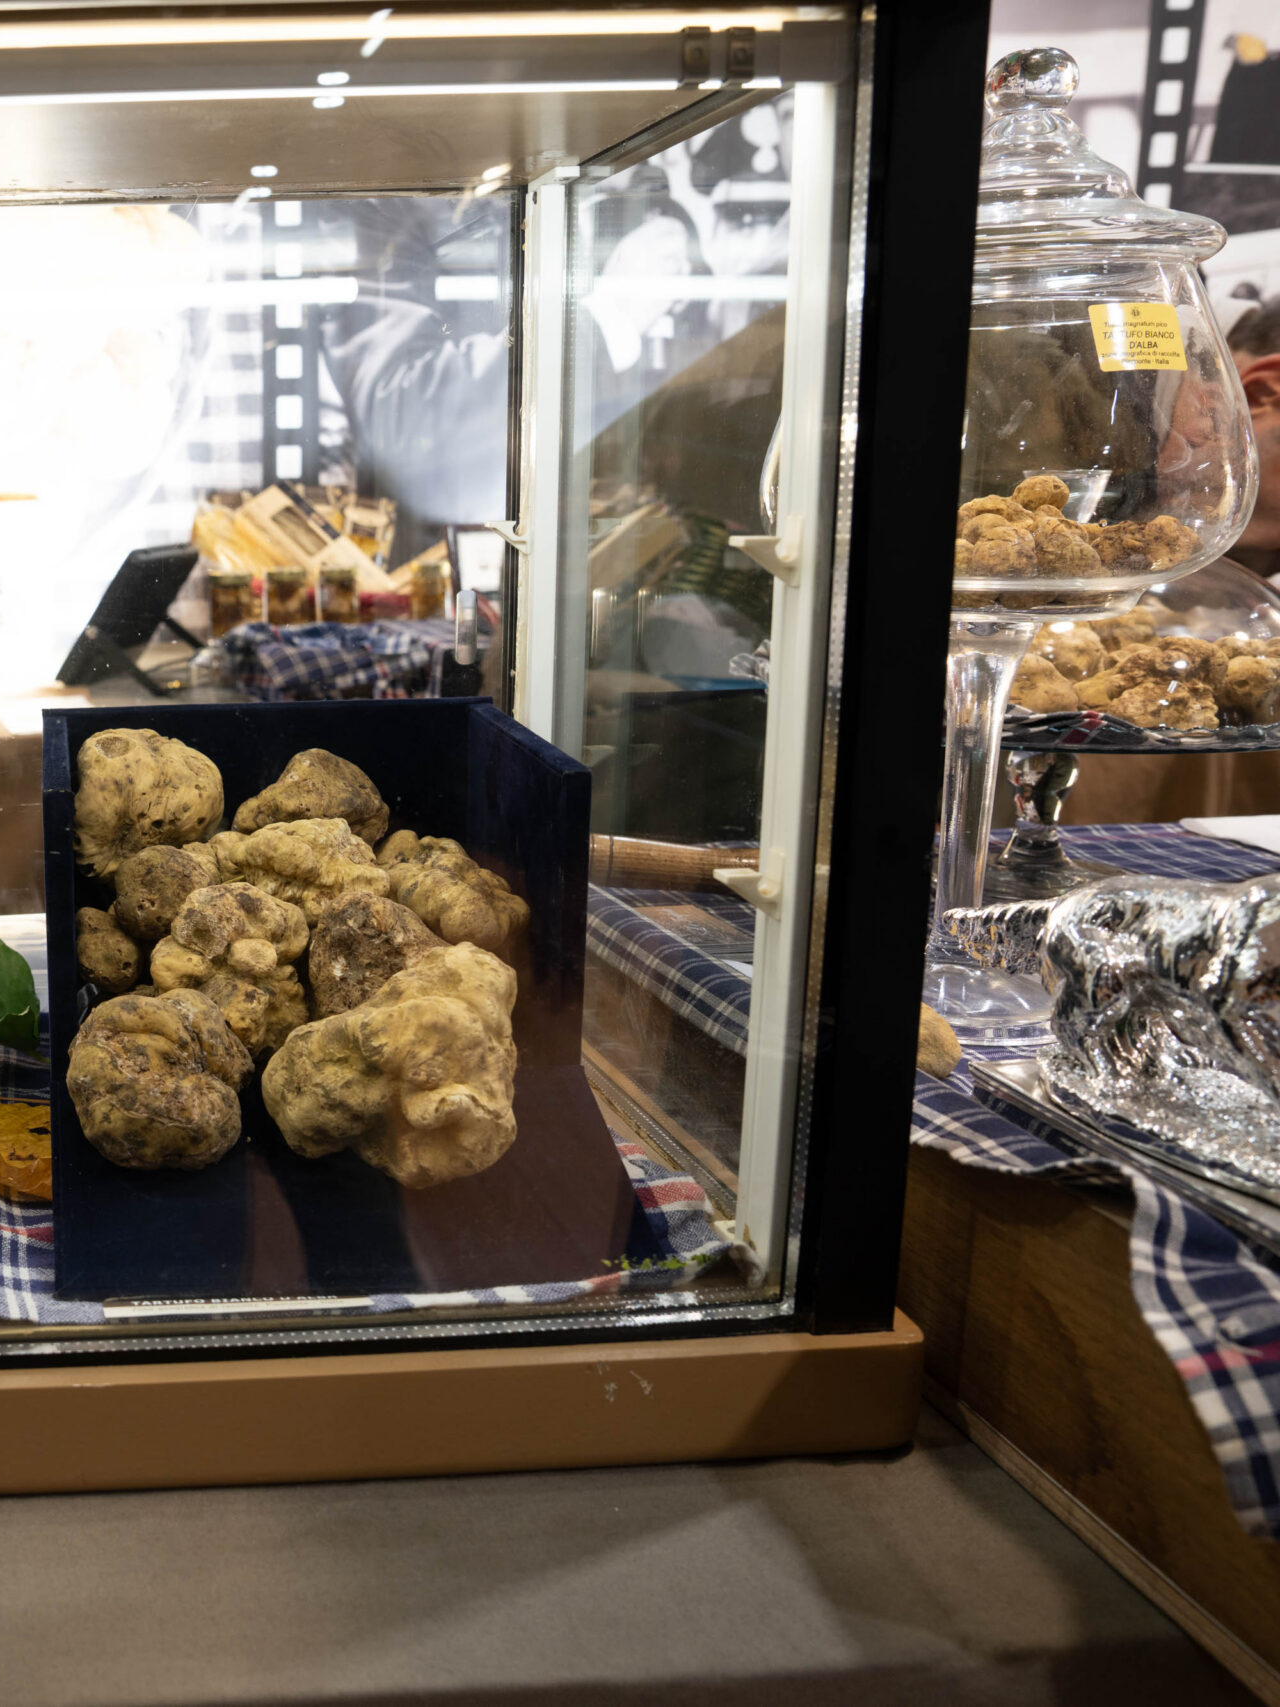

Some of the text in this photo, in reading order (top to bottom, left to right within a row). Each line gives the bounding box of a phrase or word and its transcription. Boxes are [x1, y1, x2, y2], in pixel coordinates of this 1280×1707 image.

[1103, 331, 1175, 339] TATUFO BIANCO
[1129, 341, 1158, 349] D'ALBA
